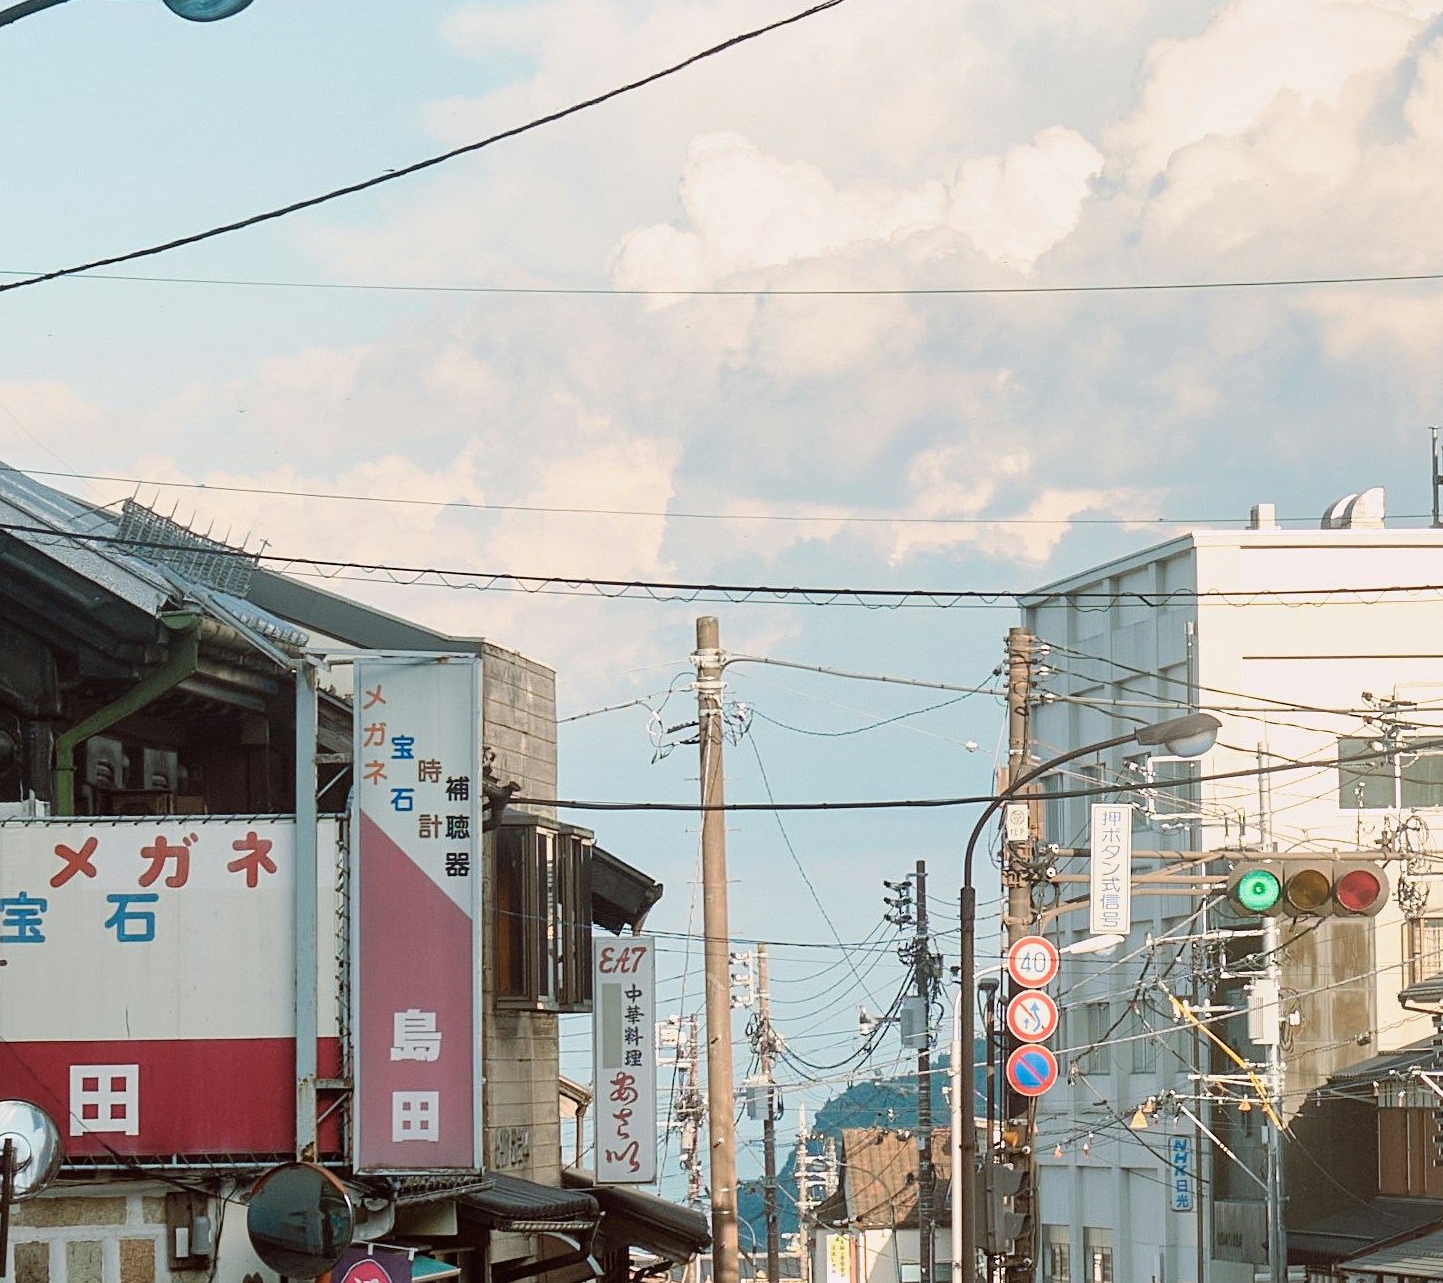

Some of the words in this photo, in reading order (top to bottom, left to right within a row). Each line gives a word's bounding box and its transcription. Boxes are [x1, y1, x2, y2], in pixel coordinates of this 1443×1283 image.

[361, 684, 388, 786] メガネ
[390, 734, 416, 813] 宝石
[417, 759, 443, 840] 時計
[444, 775, 471, 877] 補聴器
[50, 830, 279, 890] メガネ
[1099, 810, 1122, 928] 押ボタン式信号
[598, 946, 647, 974] EAT
[1020, 951, 1046, 973] 40
[623, 983, 645, 1067] 中華料理
[390, 1008, 443, 1143] 島田
